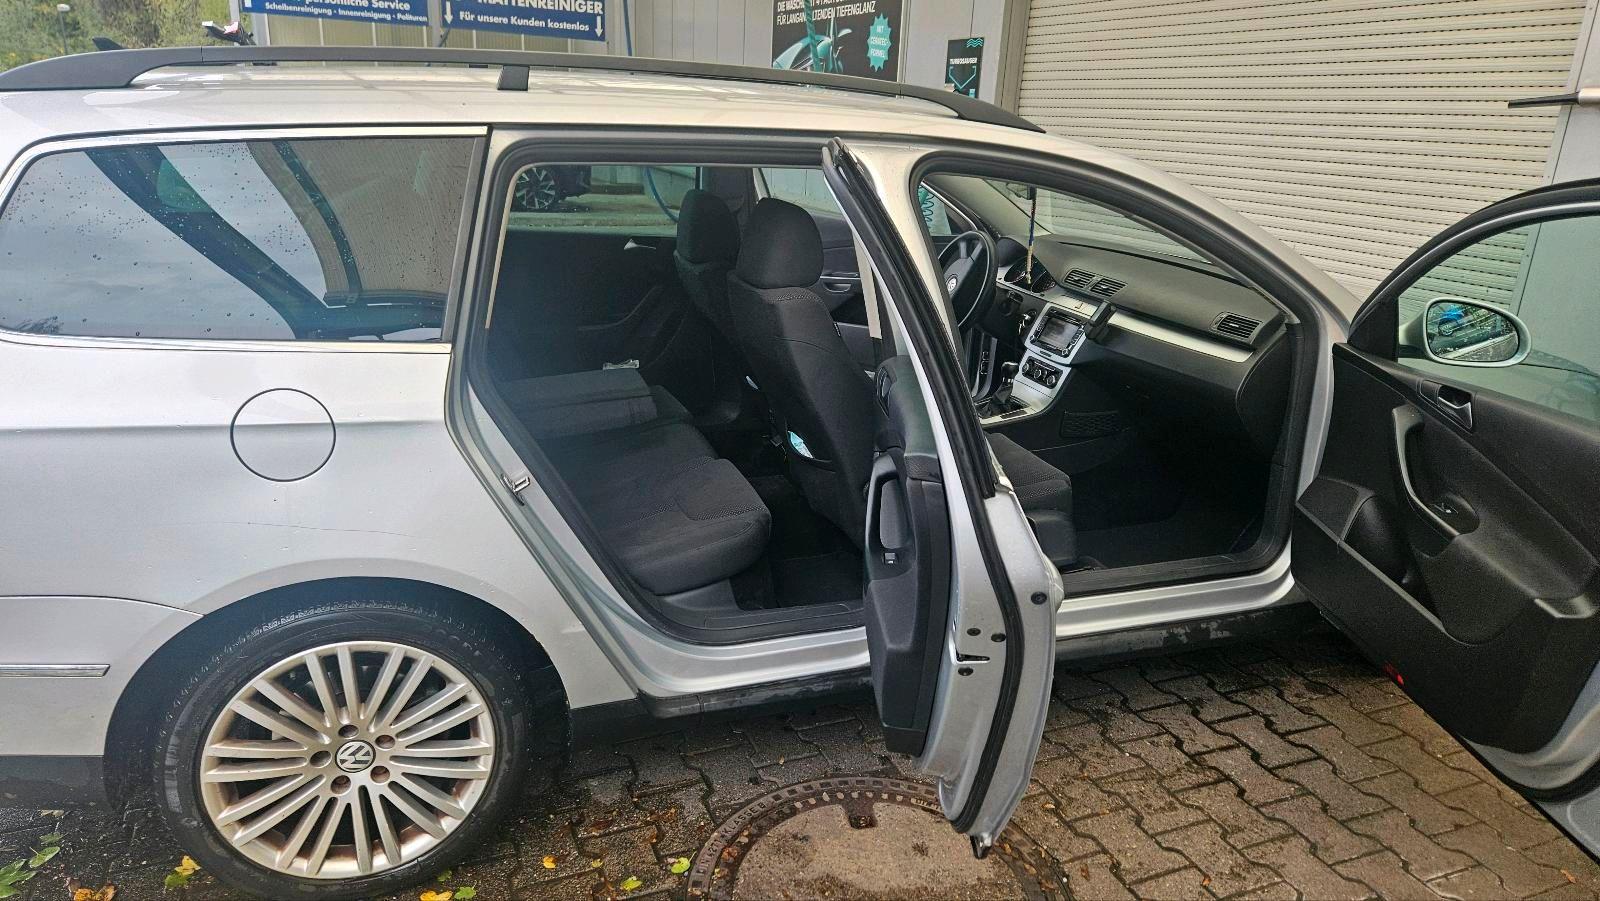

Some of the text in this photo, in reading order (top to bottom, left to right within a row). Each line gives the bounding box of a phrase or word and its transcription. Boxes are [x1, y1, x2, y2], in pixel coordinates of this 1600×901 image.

[265, 3, 428, 22] Scheibenreinigung Innenreinigung Polituren
[371, 0, 410, 10] Service
[478, 0, 603, 15] ENREINIGER
[777, 1, 786, 12] DIE
[777, 1, 876, 25] FÜR LANGANLTENDEN TIEFENGLANZ
[460, 11, 589, 31] Für unsere Kunden kostenlos
